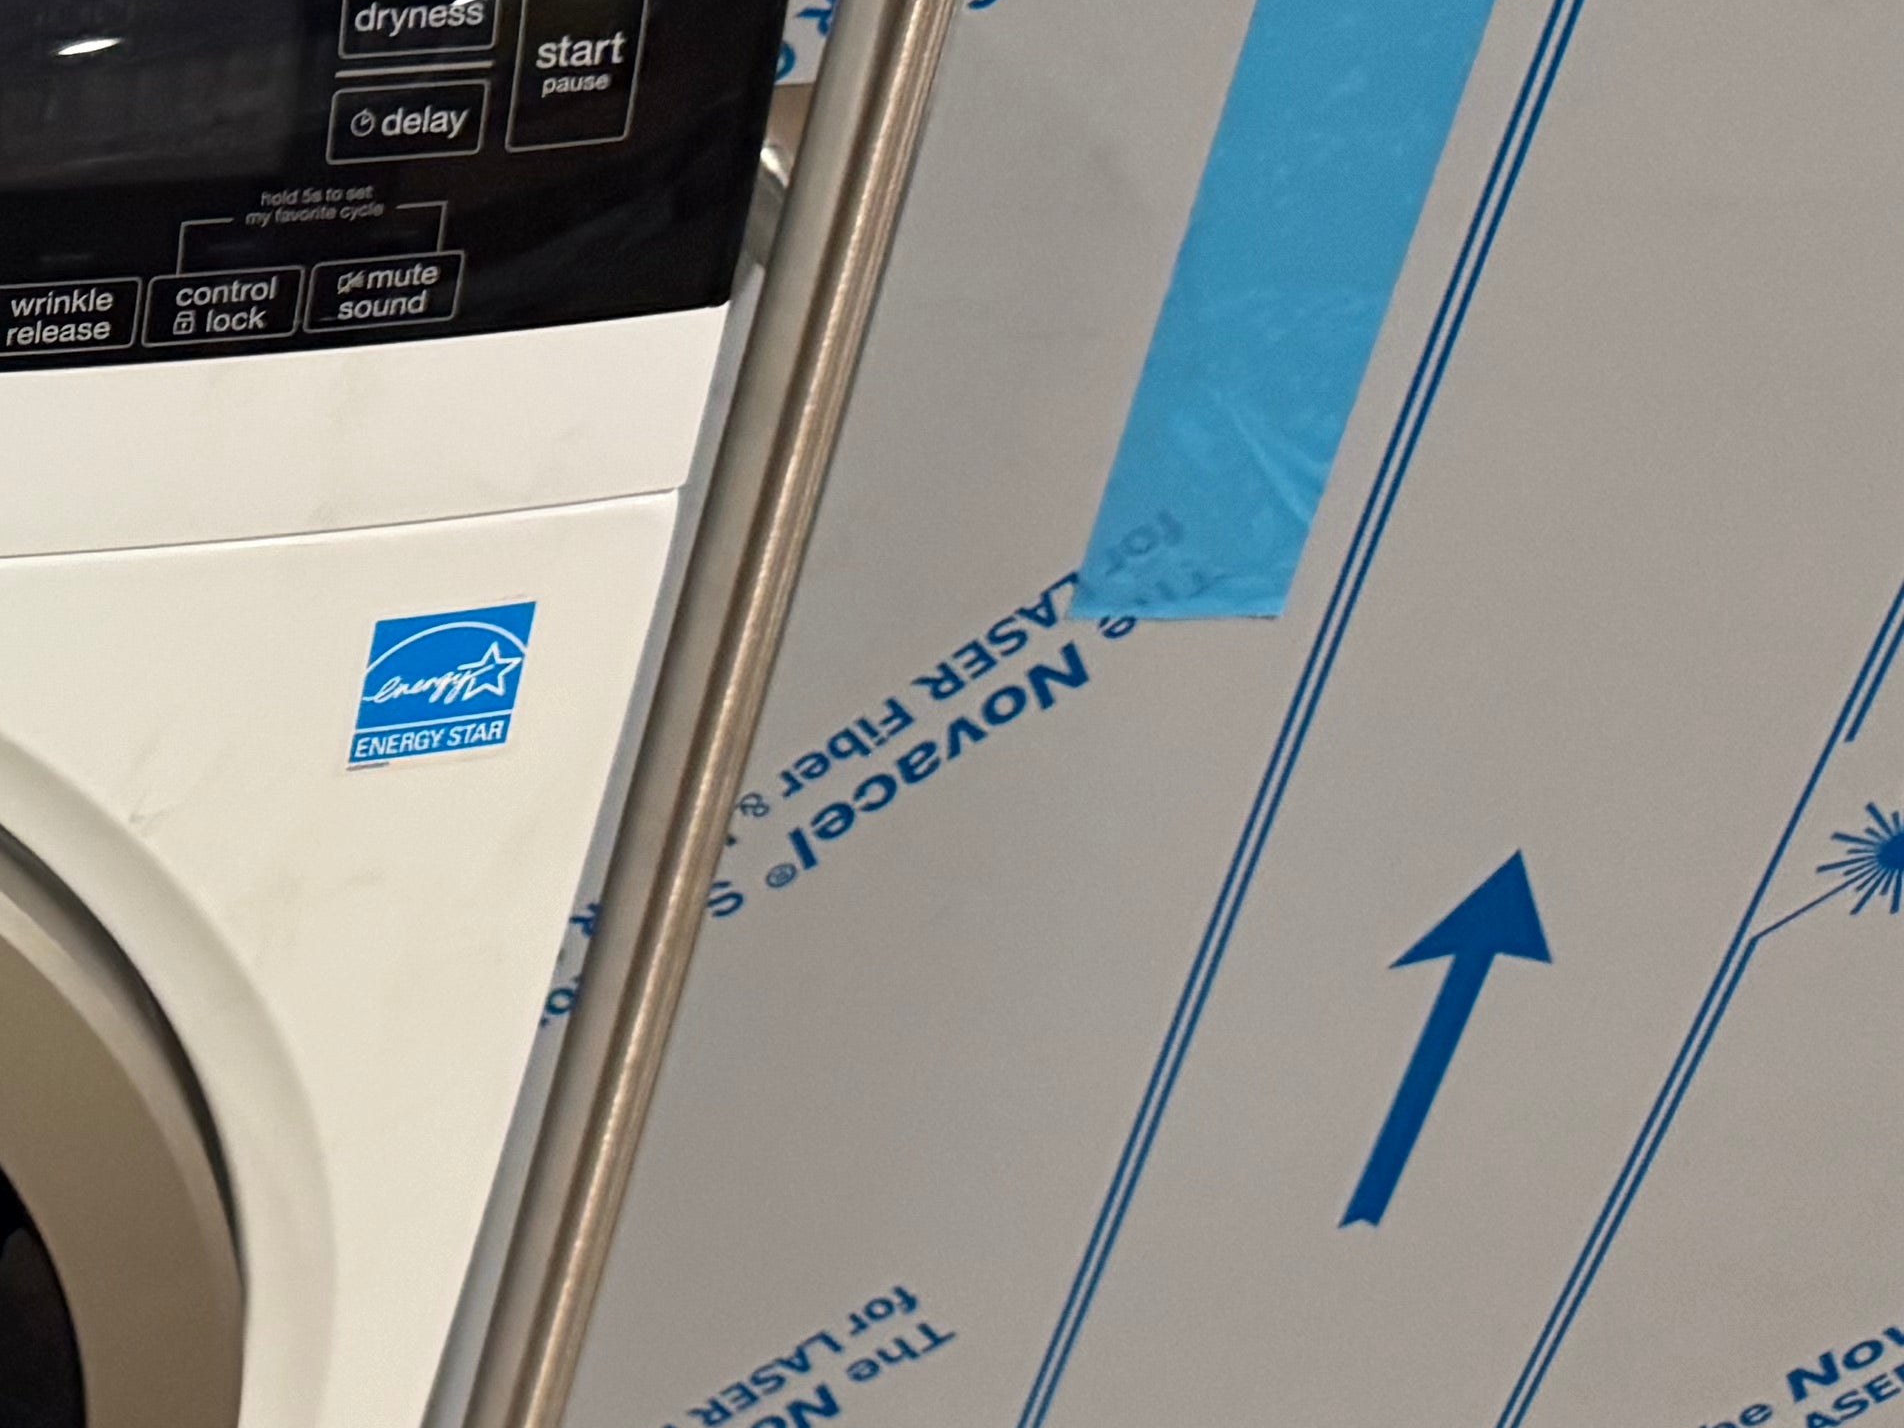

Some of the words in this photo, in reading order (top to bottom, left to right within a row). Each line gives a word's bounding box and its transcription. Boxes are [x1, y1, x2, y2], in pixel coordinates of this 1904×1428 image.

[535, 32, 624, 69] start
[540, 71, 610, 97] pause
[381, 105, 467, 142] delay
[260, 188, 297, 207] hold
[325, 187, 343, 203] to
[345, 184, 375, 201] set
[244, 209, 272, 227] my
[274, 204, 336, 223] favorite
[338, 201, 386, 221] cycle
[175, 275, 278, 307] control
[366, 262, 439, 289] mute
[9, 288, 114, 317] wrinkle
[337, 290, 428, 320] sound
[5, 316, 111, 345] release
[205, 305, 268, 333] lock
[354, 729, 444, 758] ENERGY
[447, 720, 505, 746] STAR
[781, 696, 914, 801] Fiber
[849, 1286, 919, 1337] for
[846, 1322, 957, 1384] The
[686, 1330, 845, 1428] LASER
